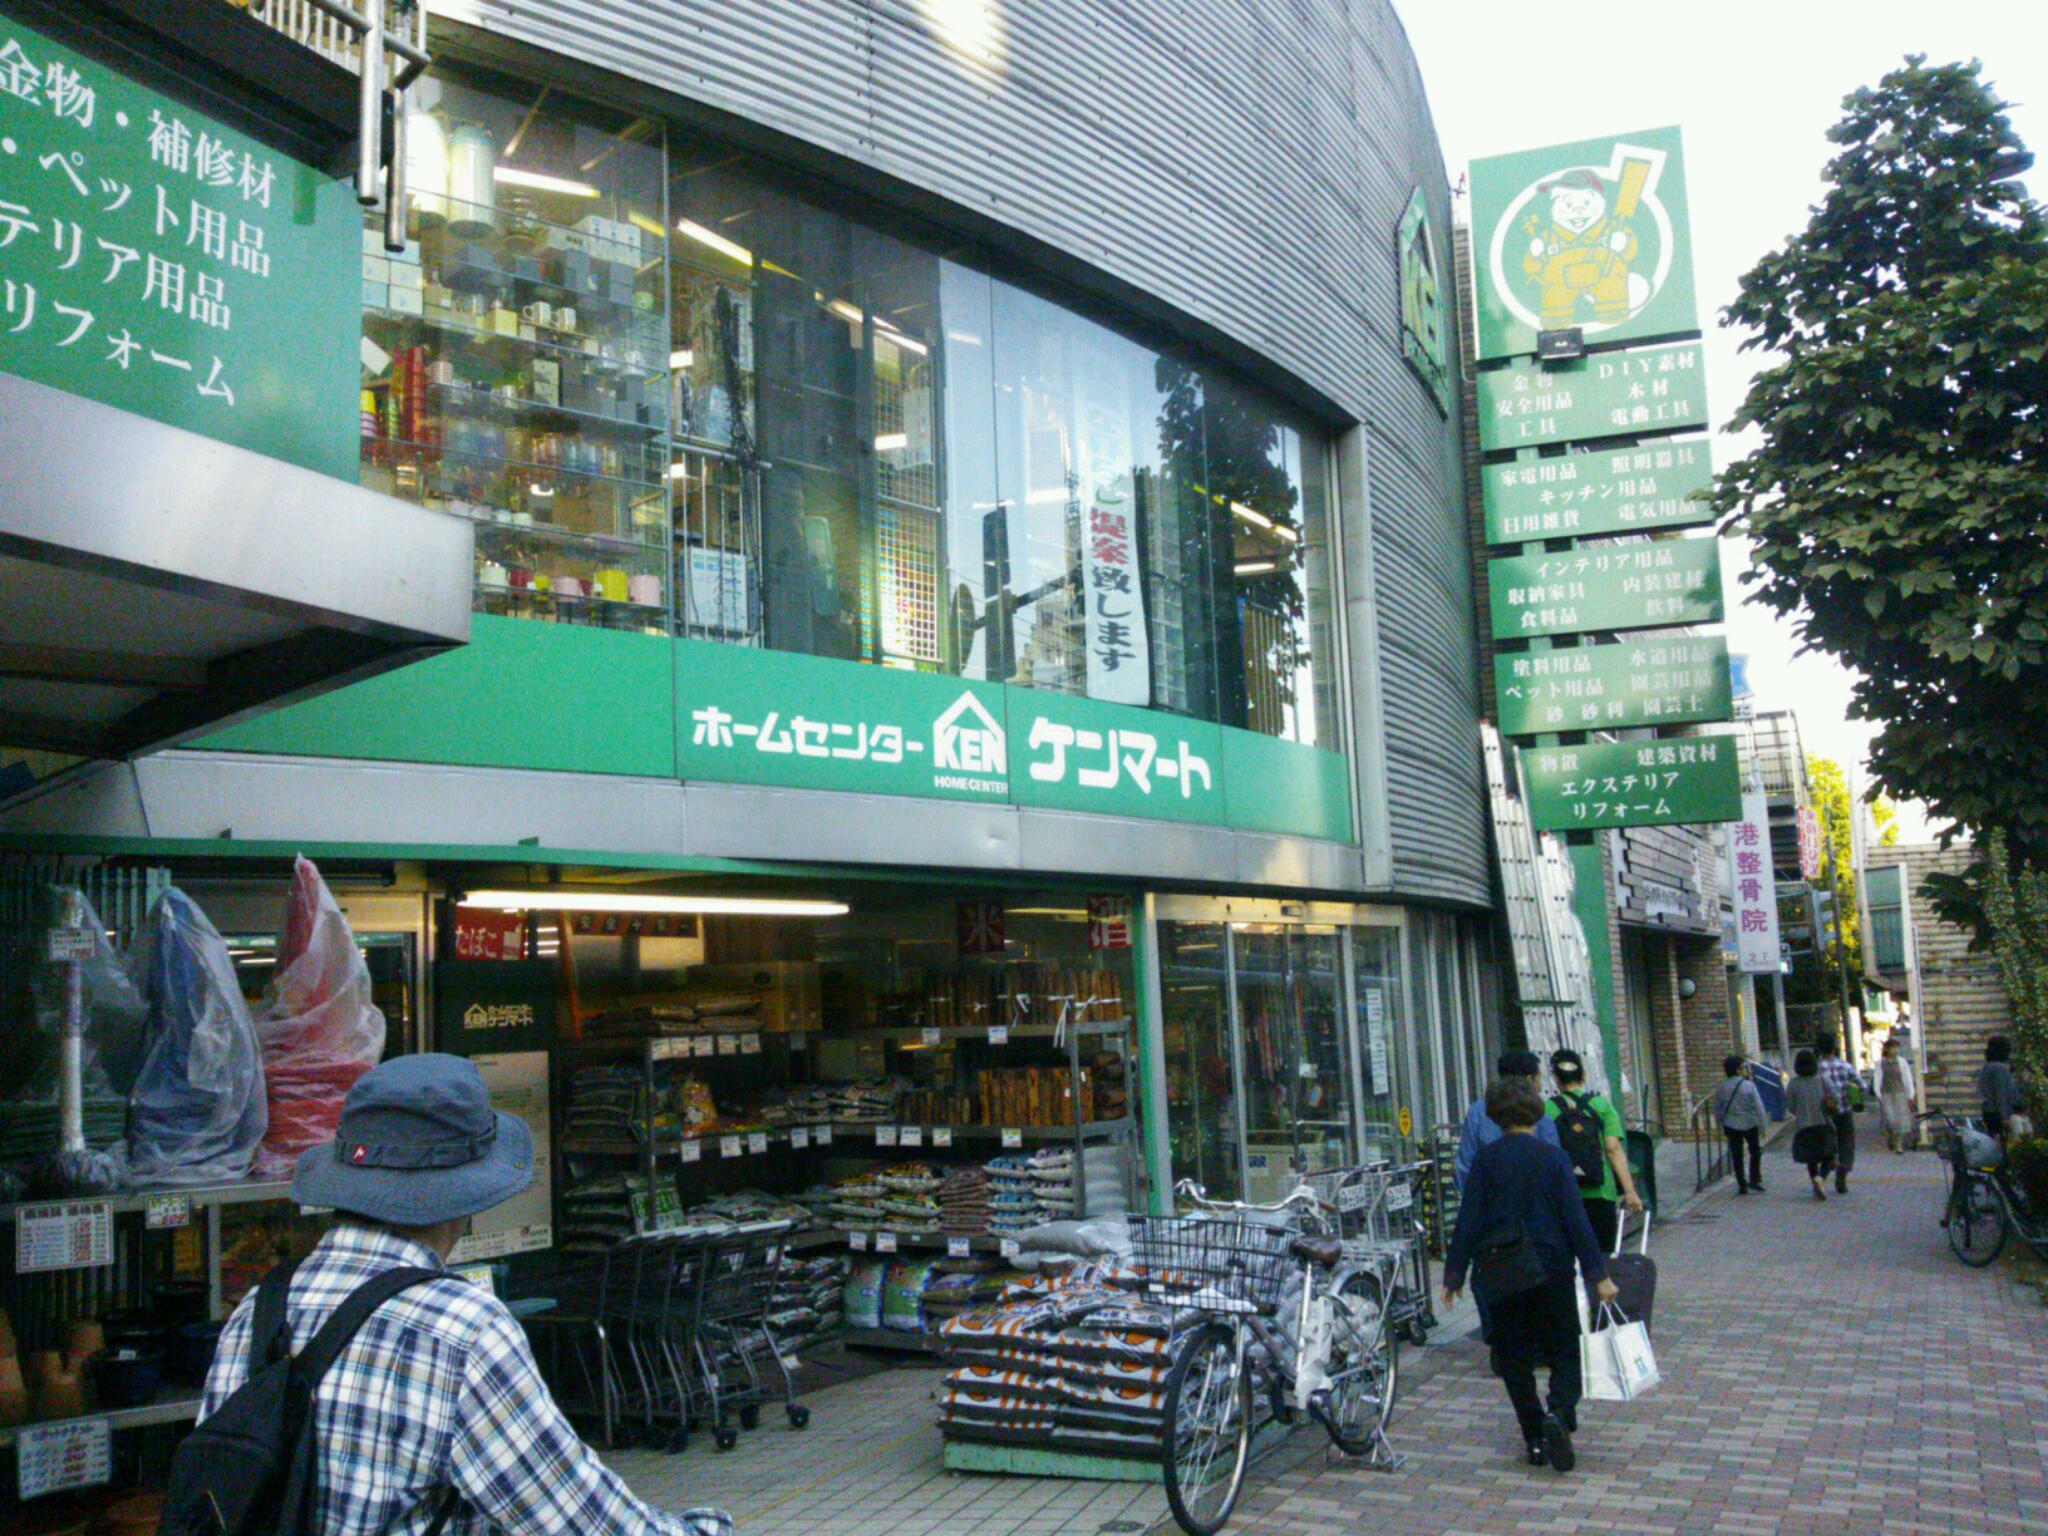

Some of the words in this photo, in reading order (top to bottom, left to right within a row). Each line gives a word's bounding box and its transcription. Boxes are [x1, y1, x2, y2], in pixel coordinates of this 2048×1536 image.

[0, 38, 276, 208] 金物・補修材
[0, 203, 231, 330] テリア用品
[5, 279, 234, 406] リフォーム
[1513, 373, 1553, 391] 金物
[1628, 378, 1669, 400] 木材
[1496, 392, 1573, 417] 安全用品
[1611, 400, 1690, 426] 電動工具
[1518, 418, 1557, 437] 工具
[1612, 447, 1695, 474] 照明器具
[1501, 463, 1577, 487] 家電用品
[1539, 477, 1657, 505] キッチン用品
[1503, 509, 1580, 534] 日用雑貨
[1536, 549, 1674, 578] インテリア用品
[1508, 582, 1585, 605] 収納家具
[1521, 608, 1578, 628] 食料品
[1647, 597, 1684, 616] 飲料
[1513, 656, 1591, 677] 塗料用品
[1506, 678, 1604, 699] ペット用品
[692, 706, 924, 764] ホームセンター
[933, 725, 1007, 774] KEN
[1028, 717, 1212, 798] ケンマート
[1541, 753, 1579, 773] 物置
[1638, 744, 1717, 766] 建築資材
[1561, 772, 1680, 796] エクステリア
[1574, 798, 1671, 819] リフォーム
[1735, 822, 1768, 932] 港整骨院
[456, 924, 498, 958] たばこ
